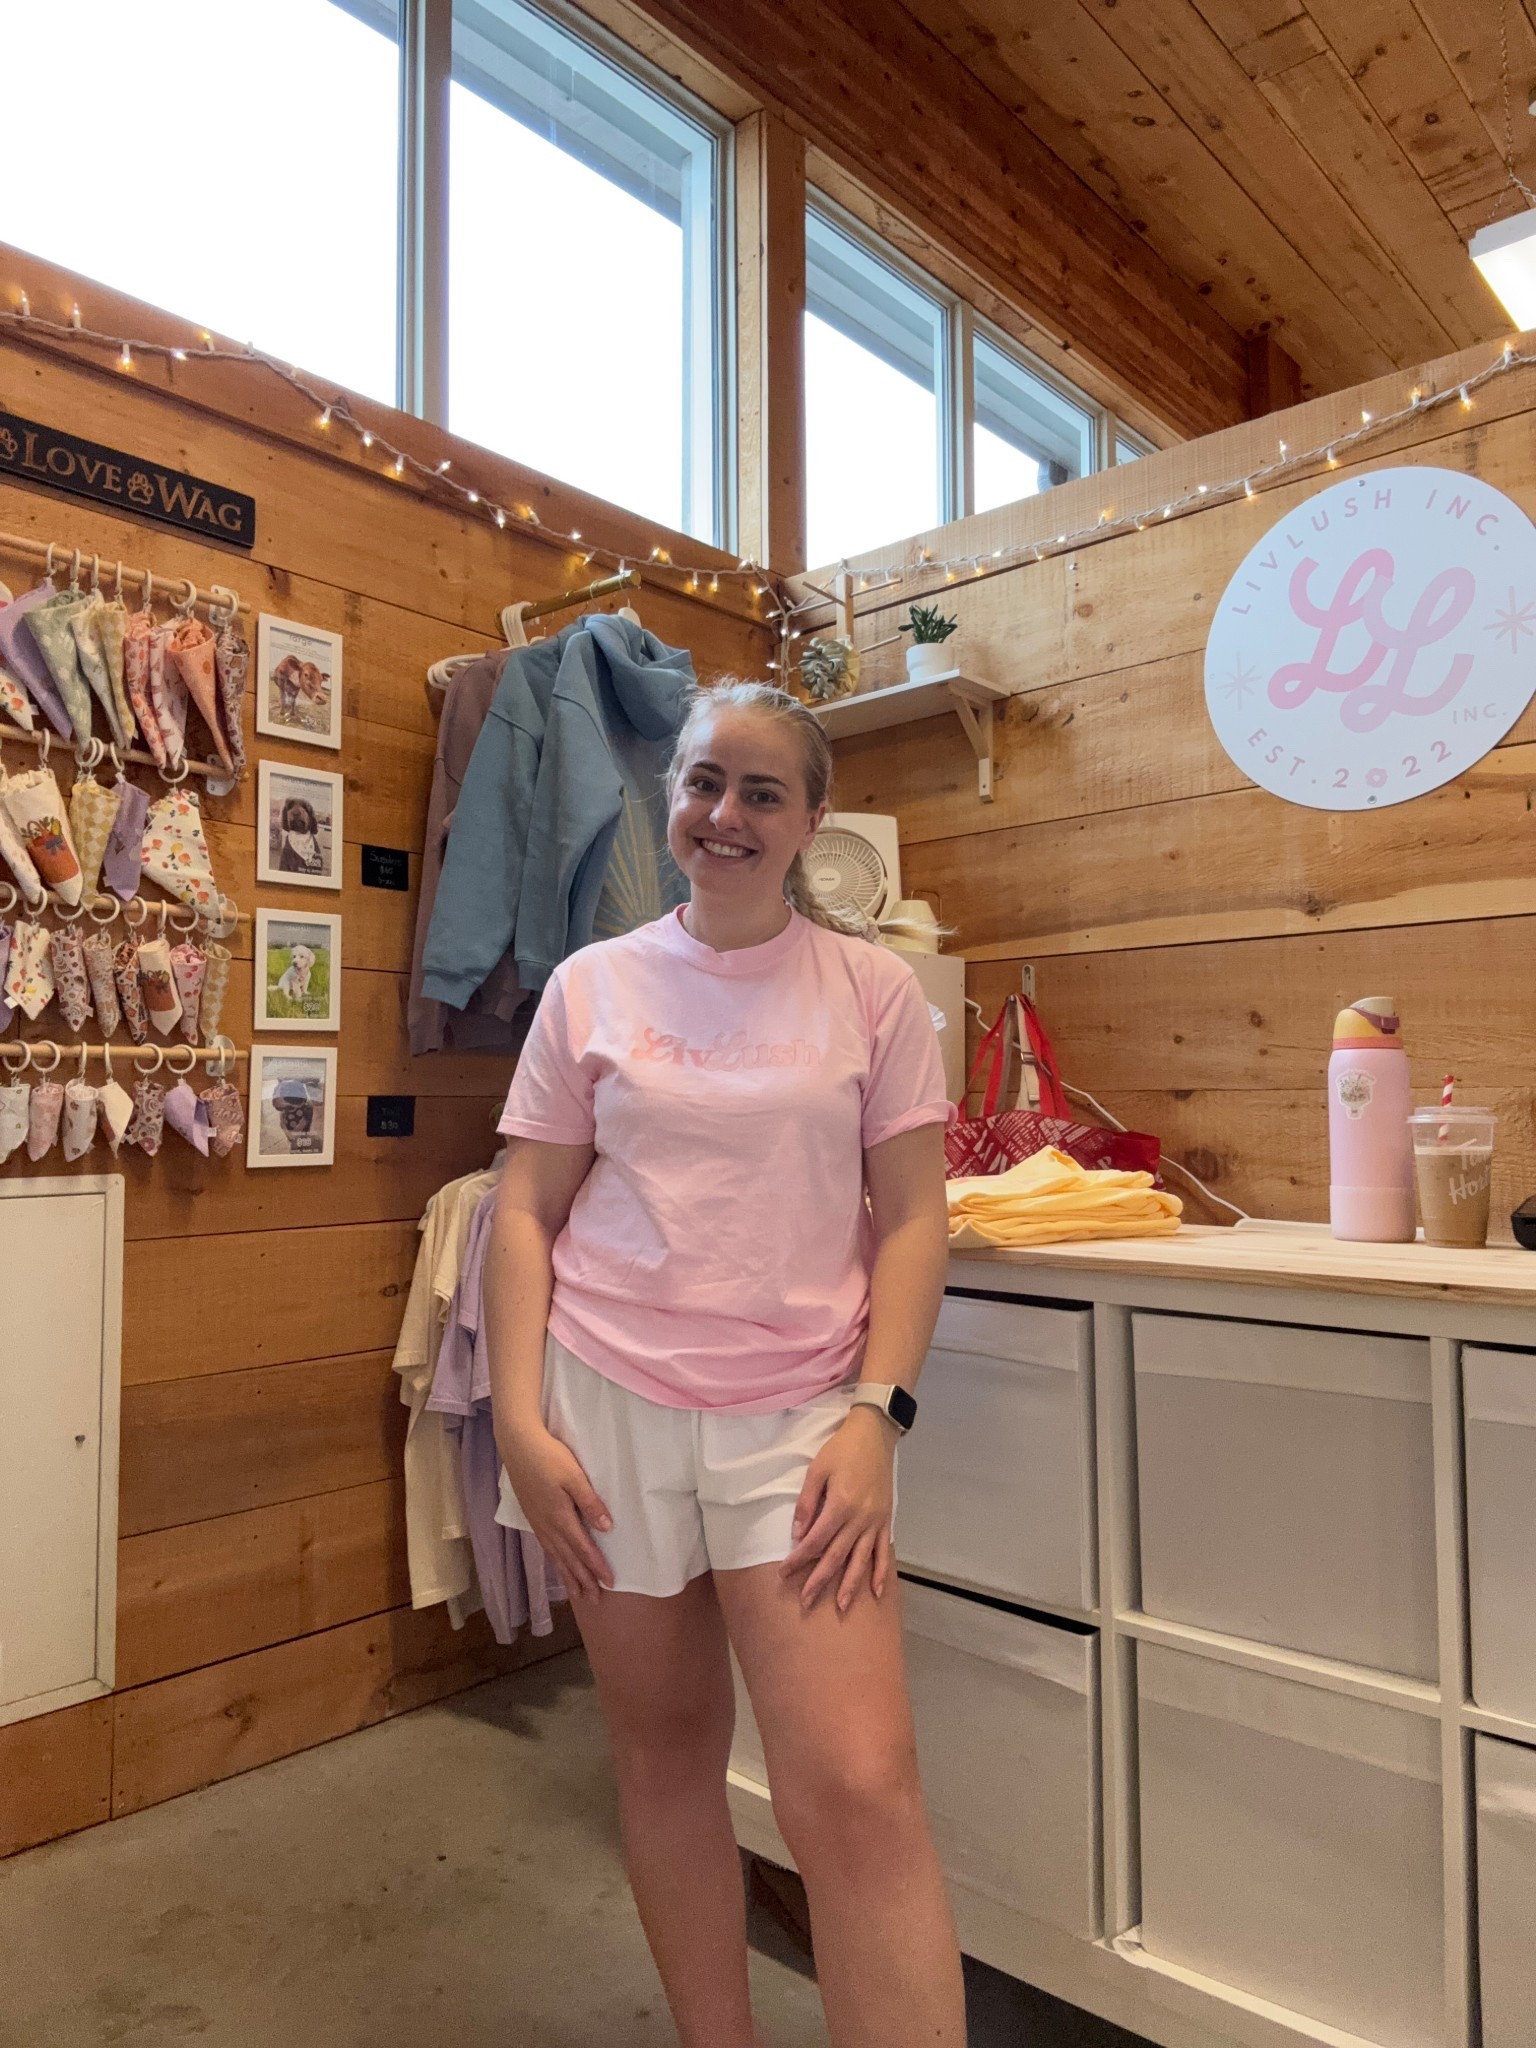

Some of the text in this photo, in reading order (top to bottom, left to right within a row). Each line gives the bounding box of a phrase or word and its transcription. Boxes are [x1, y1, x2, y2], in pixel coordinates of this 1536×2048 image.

[22, 429, 242, 531] LOVE WAG
[1232, 488, 1500, 615] LIVLUSH INC.
[1452, 703, 1508, 724] INC.
